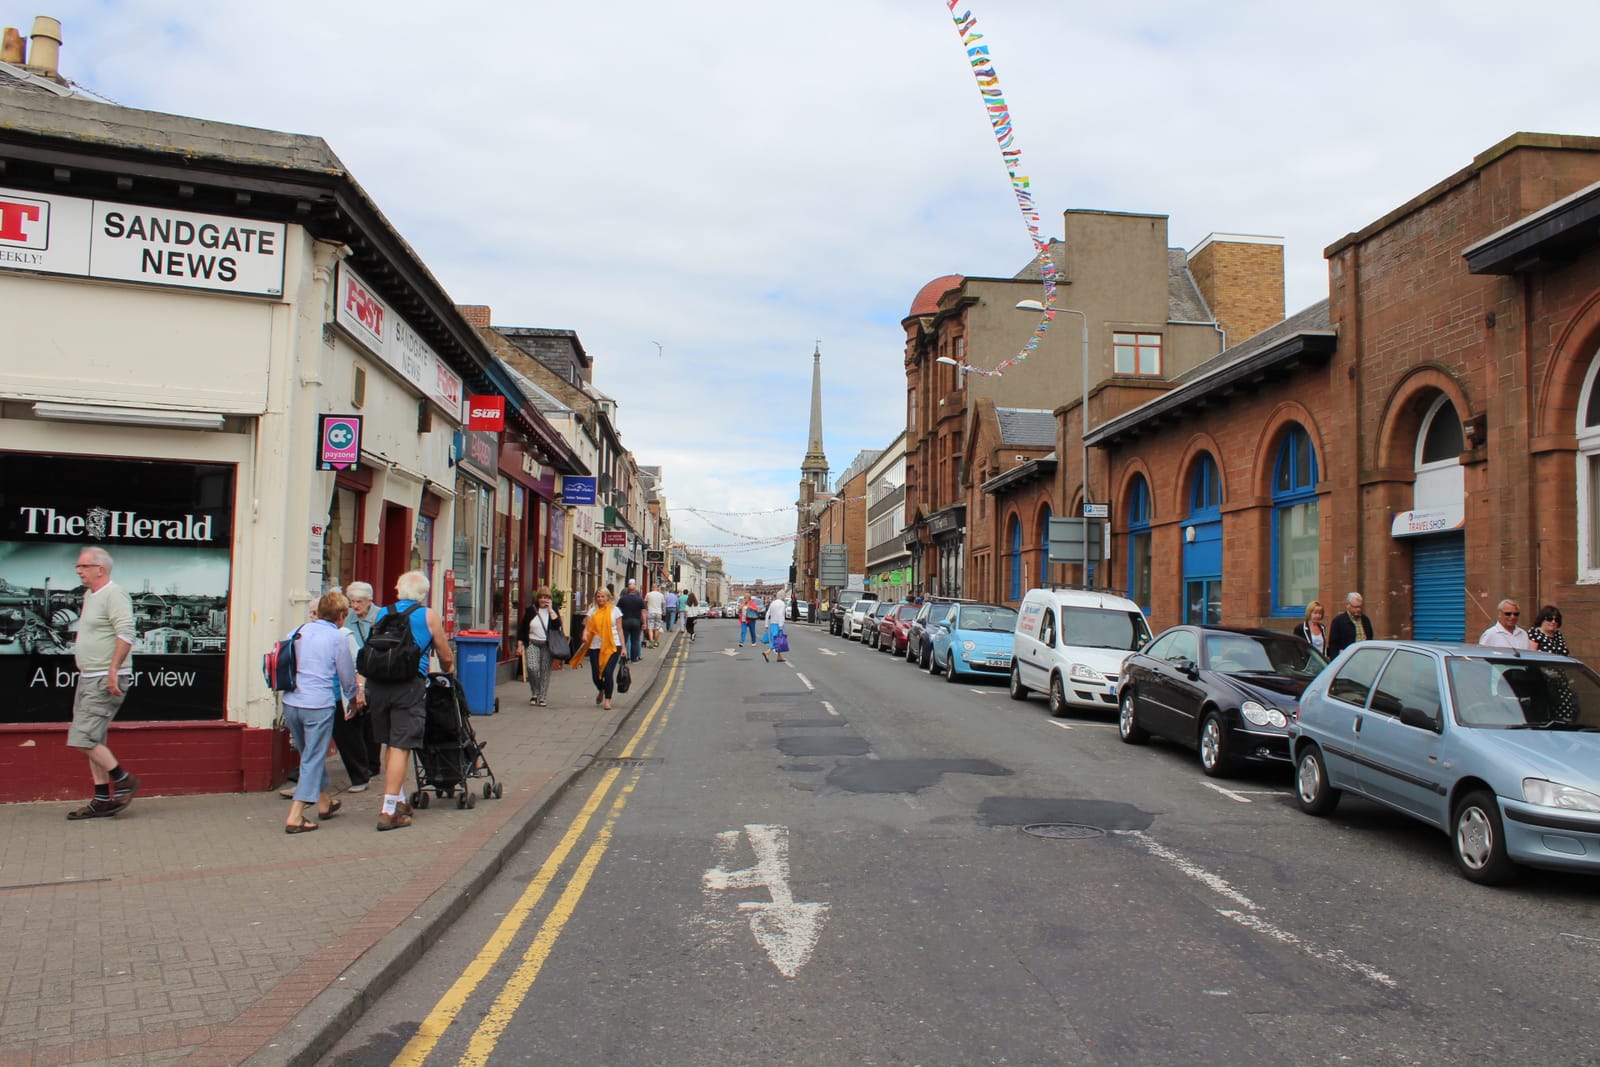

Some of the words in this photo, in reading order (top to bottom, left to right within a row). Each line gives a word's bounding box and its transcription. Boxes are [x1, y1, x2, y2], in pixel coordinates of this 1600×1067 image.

[104, 212, 275, 255] SANDGATE
[141, 248, 238, 282] NEWS
[346, 277, 385, 336] POST
[395, 322, 428, 366] SANDGATE
[402, 352, 421, 382] NEWS
[436, 363, 459, 404] POST
[324, 451, 357, 460] payzone
[20, 506, 85, 536] The
[108, 511, 213, 541] Herald
[1408, 521, 1429, 532] TRAVEL
[1429, 518, 1446, 530] SHOP
[30, 667, 48, 687] A
[56, 667, 143, 687] brer
[148, 667, 196, 687] view
